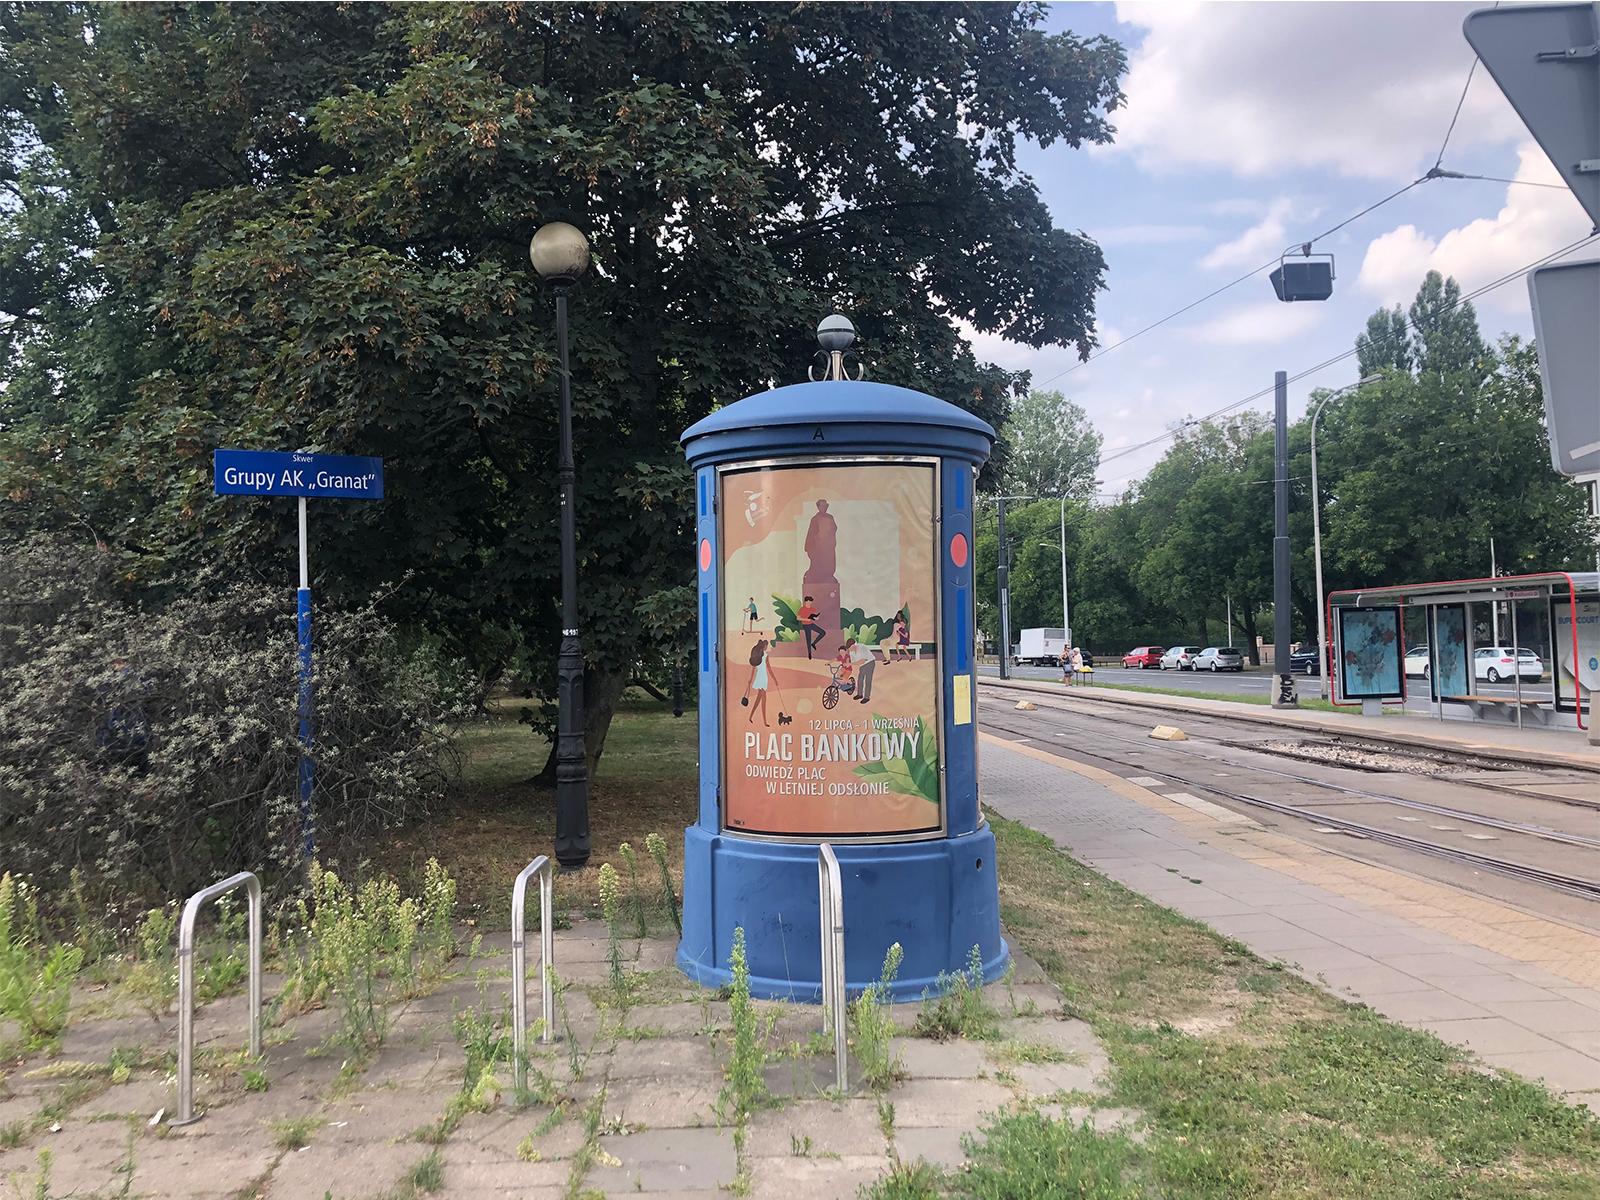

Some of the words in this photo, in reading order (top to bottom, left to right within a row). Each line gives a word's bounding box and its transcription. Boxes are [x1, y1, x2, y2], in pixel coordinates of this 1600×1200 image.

[812, 426, 825, 441] A
[292, 453, 314, 464] Skwer
[224, 467, 276, 491] Grupy
[280, 469, 305, 487] AK
[809, 719, 823, 731] 12
[825, 719, 854, 731] LIPCA
[863, 719, 869, 730] 1
[871, 714, 920, 730] WRZEŚNIA
[745, 731, 793, 761] PLAC
[801, 731, 921, 762] BANKOWY
[745, 763, 794, 780] ODWIEDŹ
[797, 767, 827, 780] PLAC
[766, 781, 777, 794] W
[780, 782, 824, 796] LETNIEJ
[828, 781, 890, 796] ODSŁONIE
